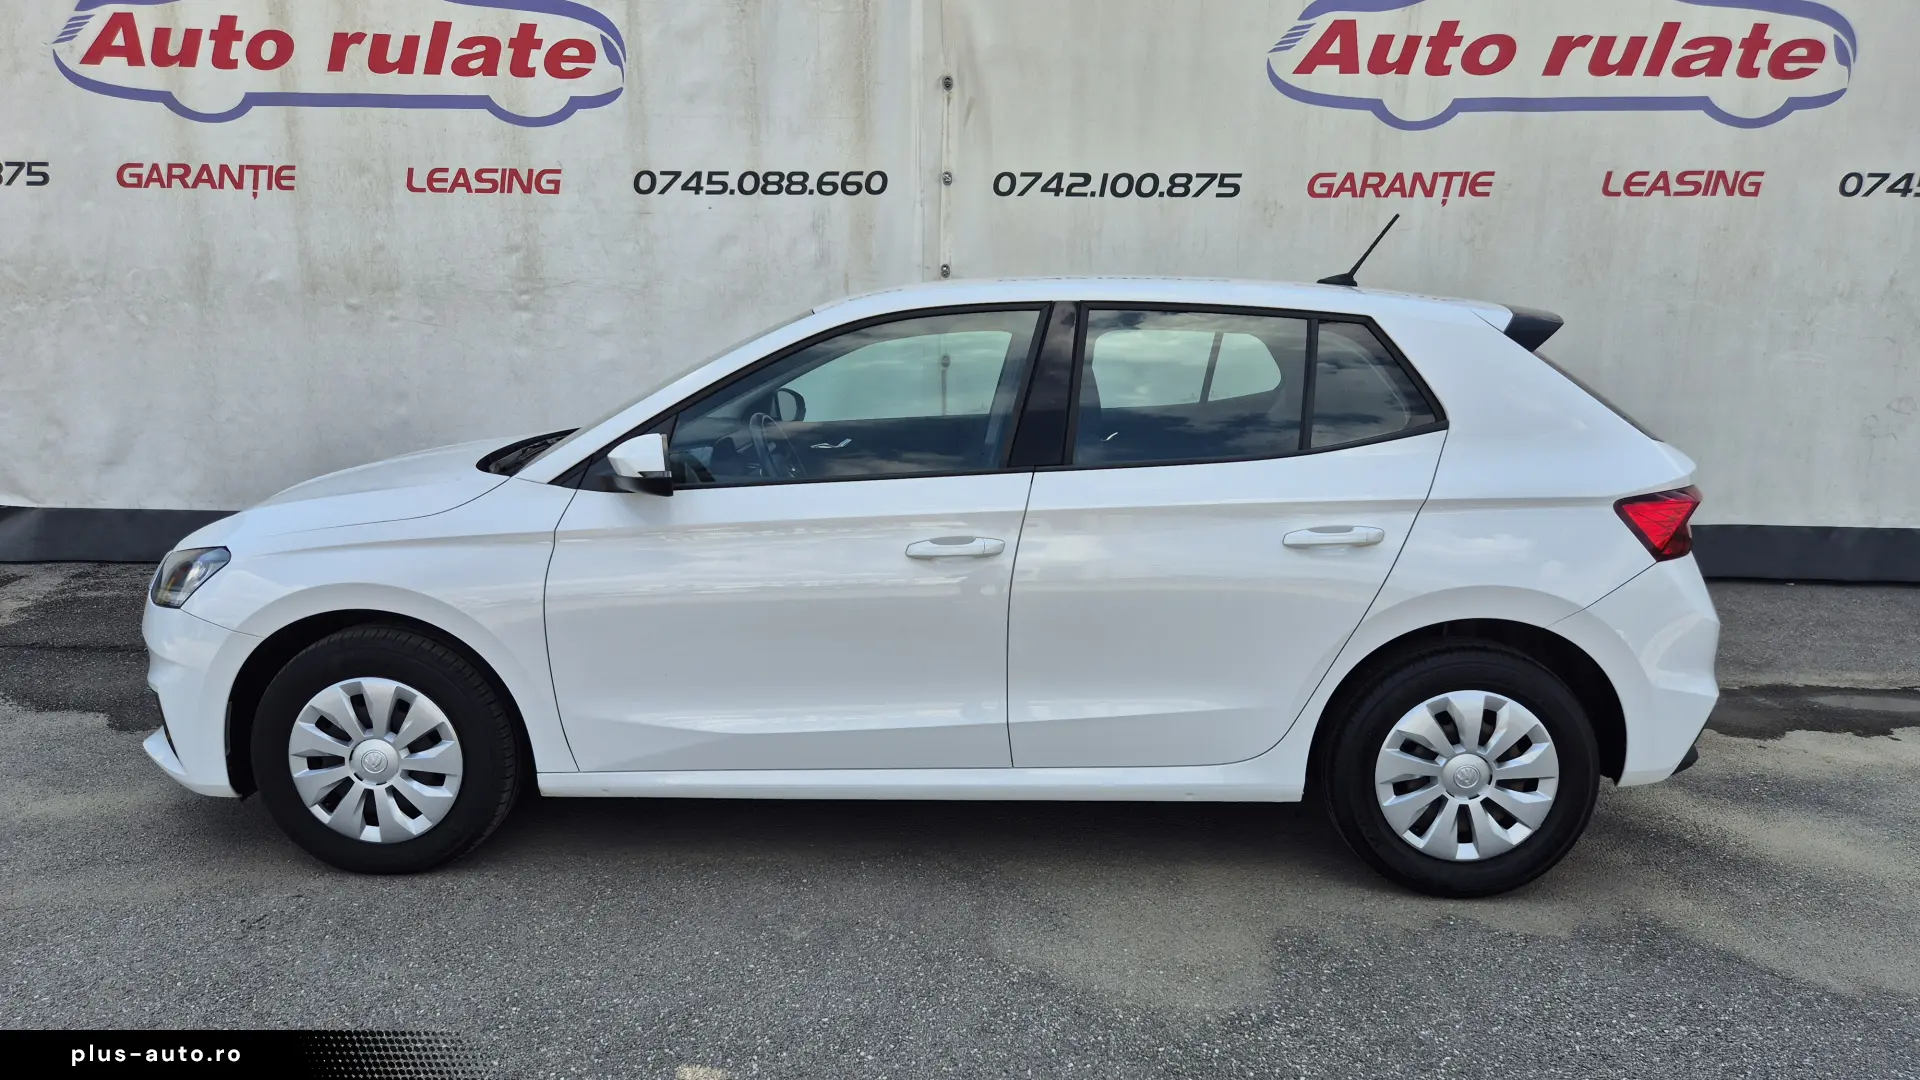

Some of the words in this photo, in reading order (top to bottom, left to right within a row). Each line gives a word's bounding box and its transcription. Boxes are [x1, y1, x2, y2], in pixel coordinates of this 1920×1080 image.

[80, 12, 295, 71] Auto
[327, 21, 597, 80] rulate
[1293, 19, 1517, 77] Auto
[1542, 21, 1827, 80] rulate
[0, 161, 50, 187] 75
[406, 167, 562, 195] LEASING
[633, 170, 888, 197] 0745.088.660
[993, 172, 1242, 198] 0742.100.875
[1602, 170, 1765, 197] LEASING
